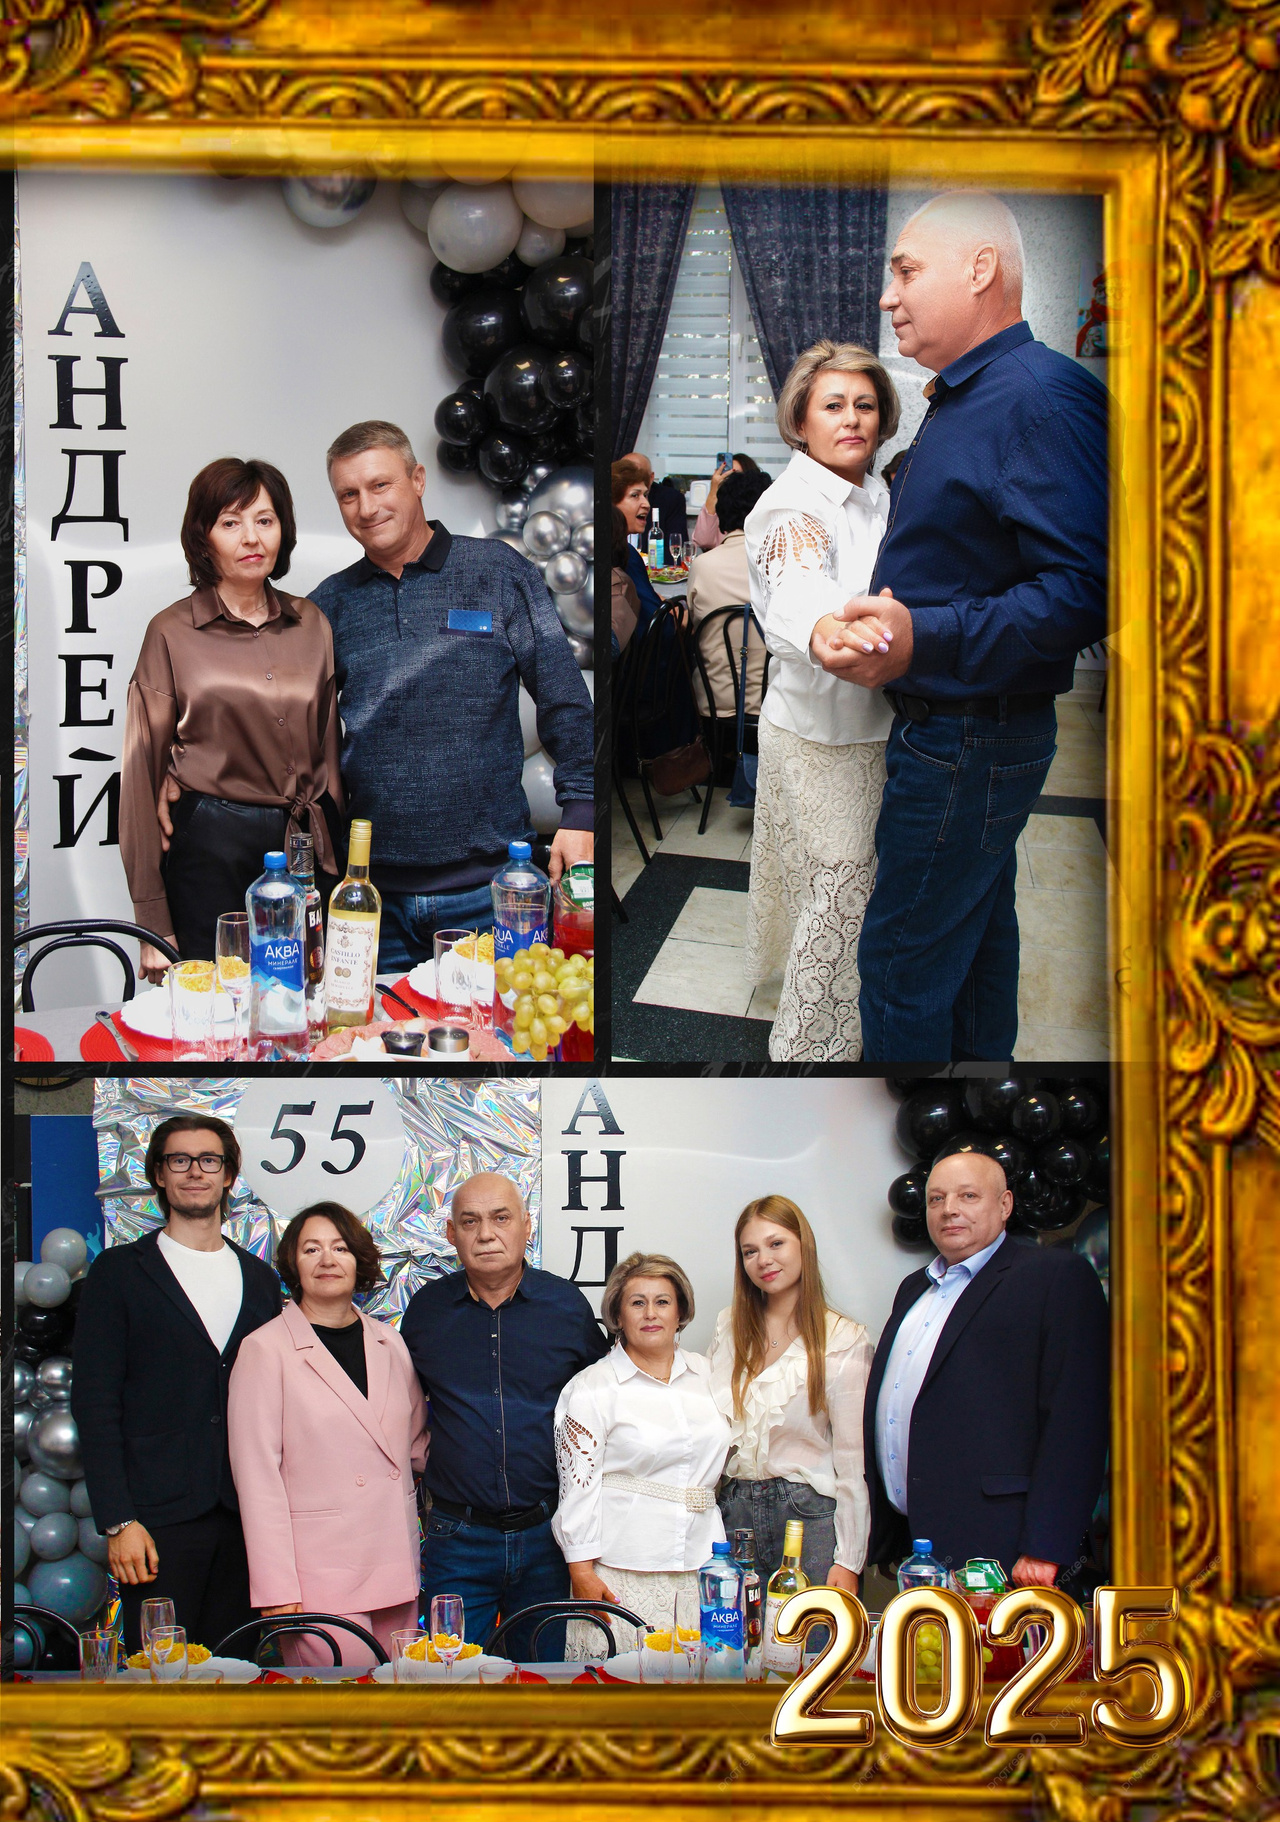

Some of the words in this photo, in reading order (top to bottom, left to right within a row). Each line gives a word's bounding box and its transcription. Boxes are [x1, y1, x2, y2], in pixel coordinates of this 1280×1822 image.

[47, 261, 129, 849] АНДРЕЙ
[264, 942, 300, 960] АКВА
[330, 948, 361, 958] CASTILLO
[260, 1100, 374, 1175] 55
[710, 1611, 740, 1624] АКВА
